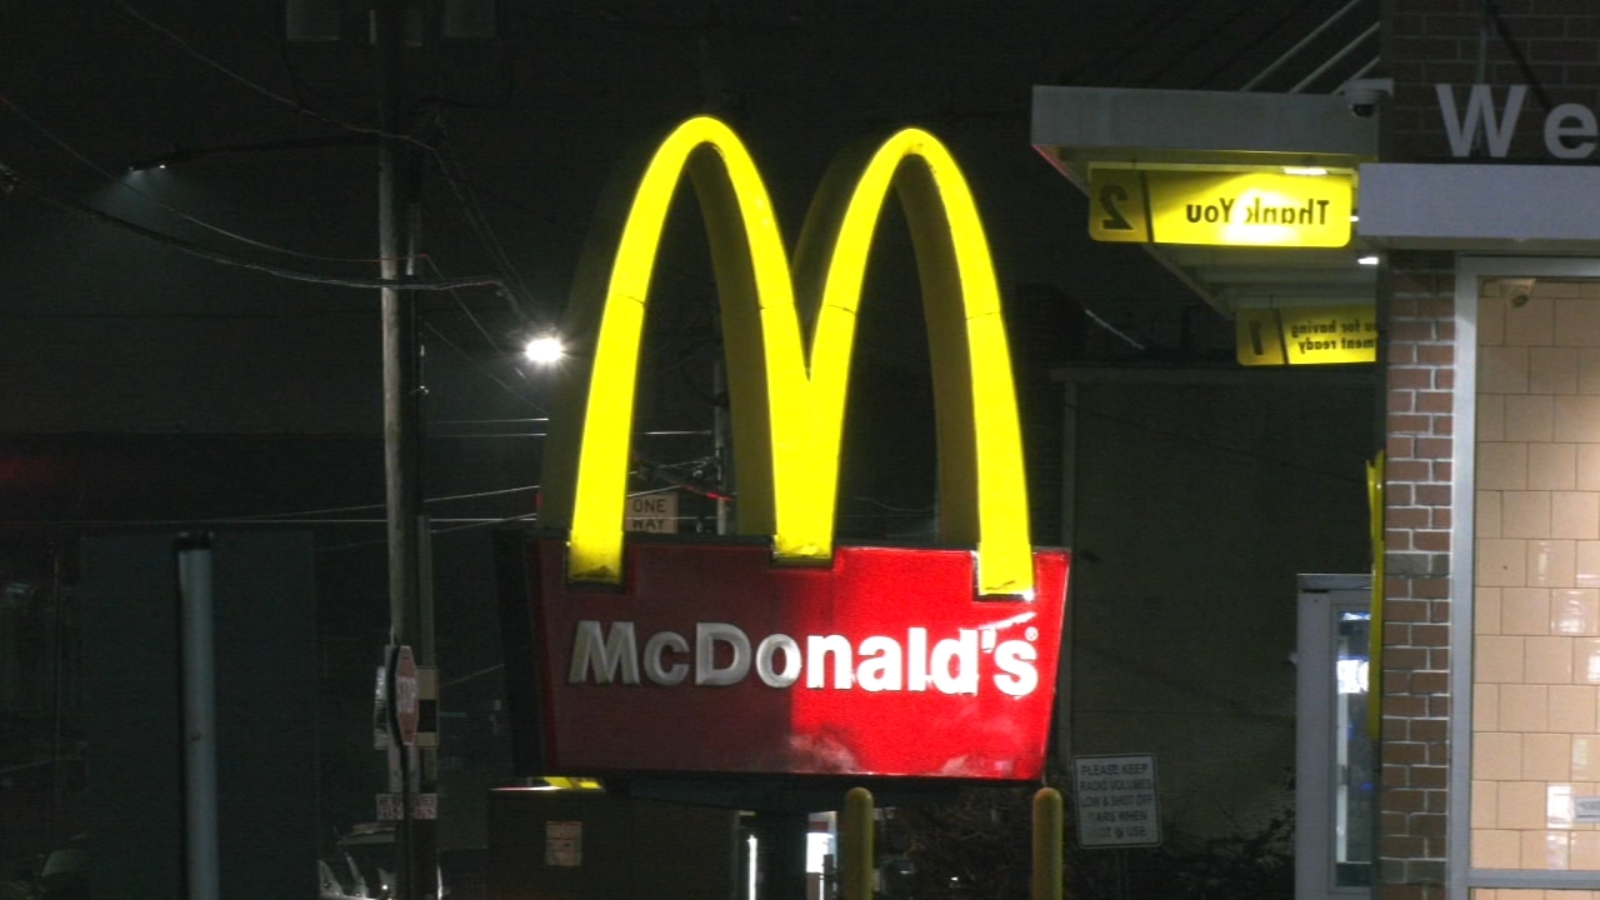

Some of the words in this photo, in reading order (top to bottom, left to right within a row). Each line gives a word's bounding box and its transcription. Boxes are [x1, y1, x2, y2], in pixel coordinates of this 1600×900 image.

[1435, 83, 1600, 159] We
[632, 498, 667, 514] ONE
[632, 518, 665, 531] WAY
[568, 619, 1038, 698] McDonald's
[1080, 763, 1120, 776] PLEASE
[1121, 763, 1148, 775] KEEP
[1079, 780, 1108, 792] RADIO
